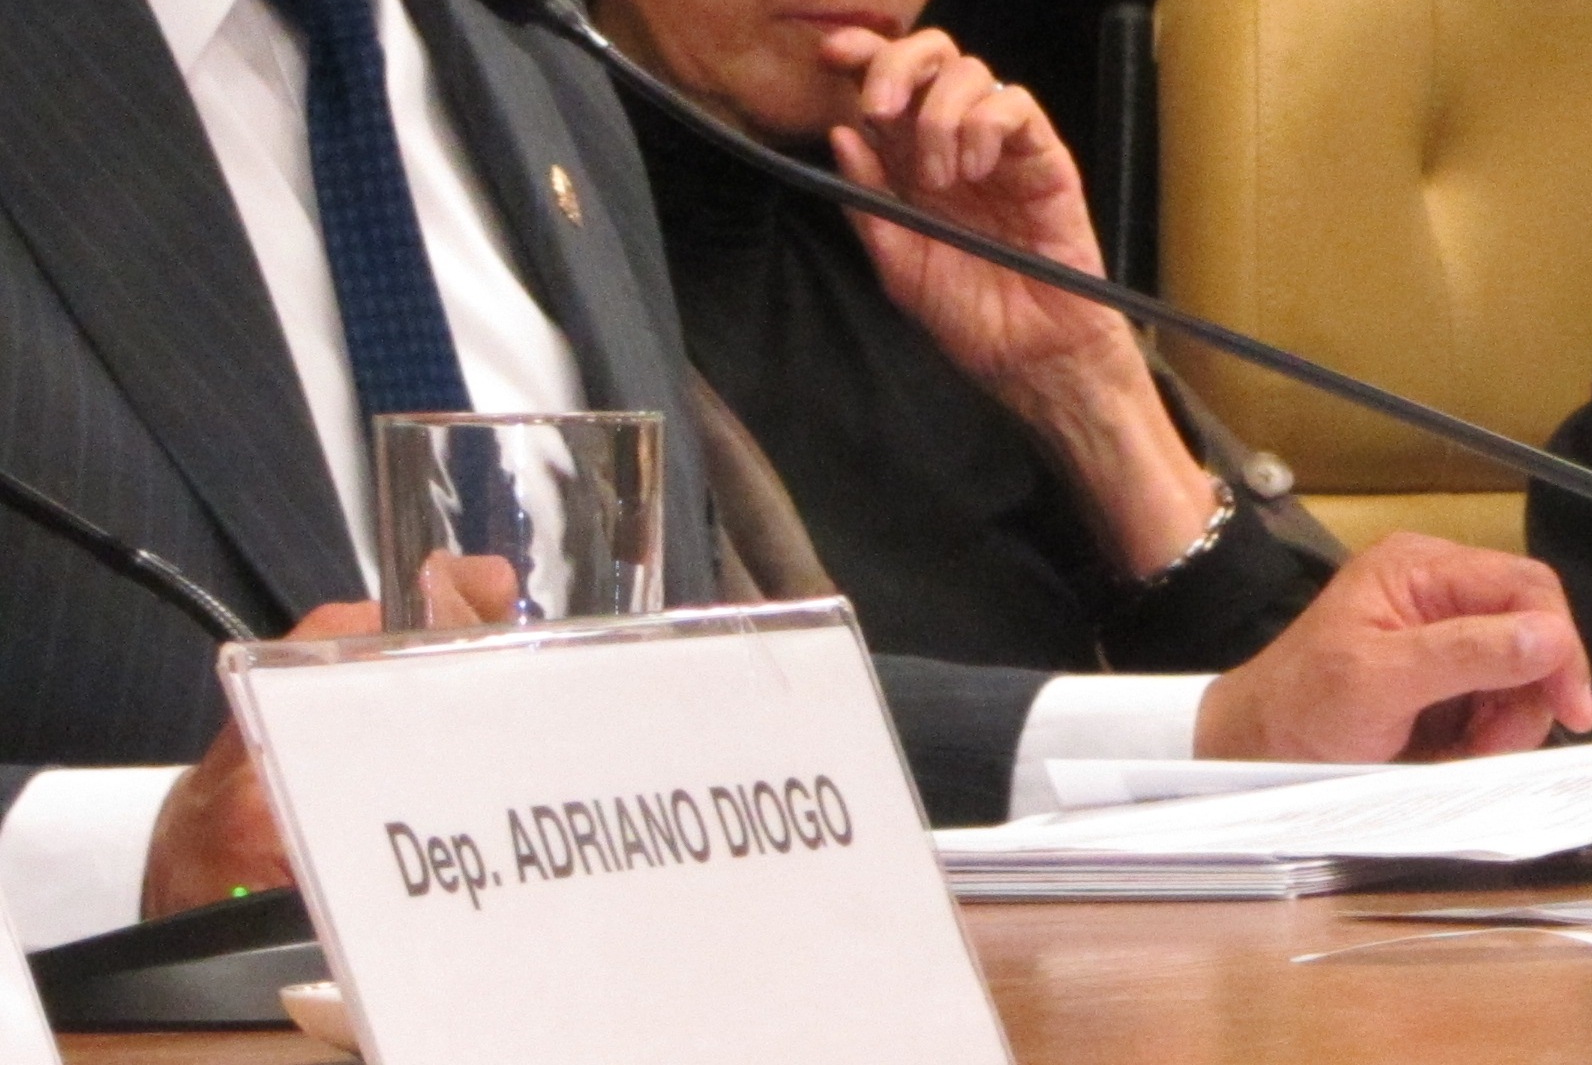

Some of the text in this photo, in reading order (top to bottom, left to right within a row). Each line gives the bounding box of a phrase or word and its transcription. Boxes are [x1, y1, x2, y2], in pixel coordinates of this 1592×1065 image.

[384, 773, 856, 911] Dep. ADRIANO DIOGO
